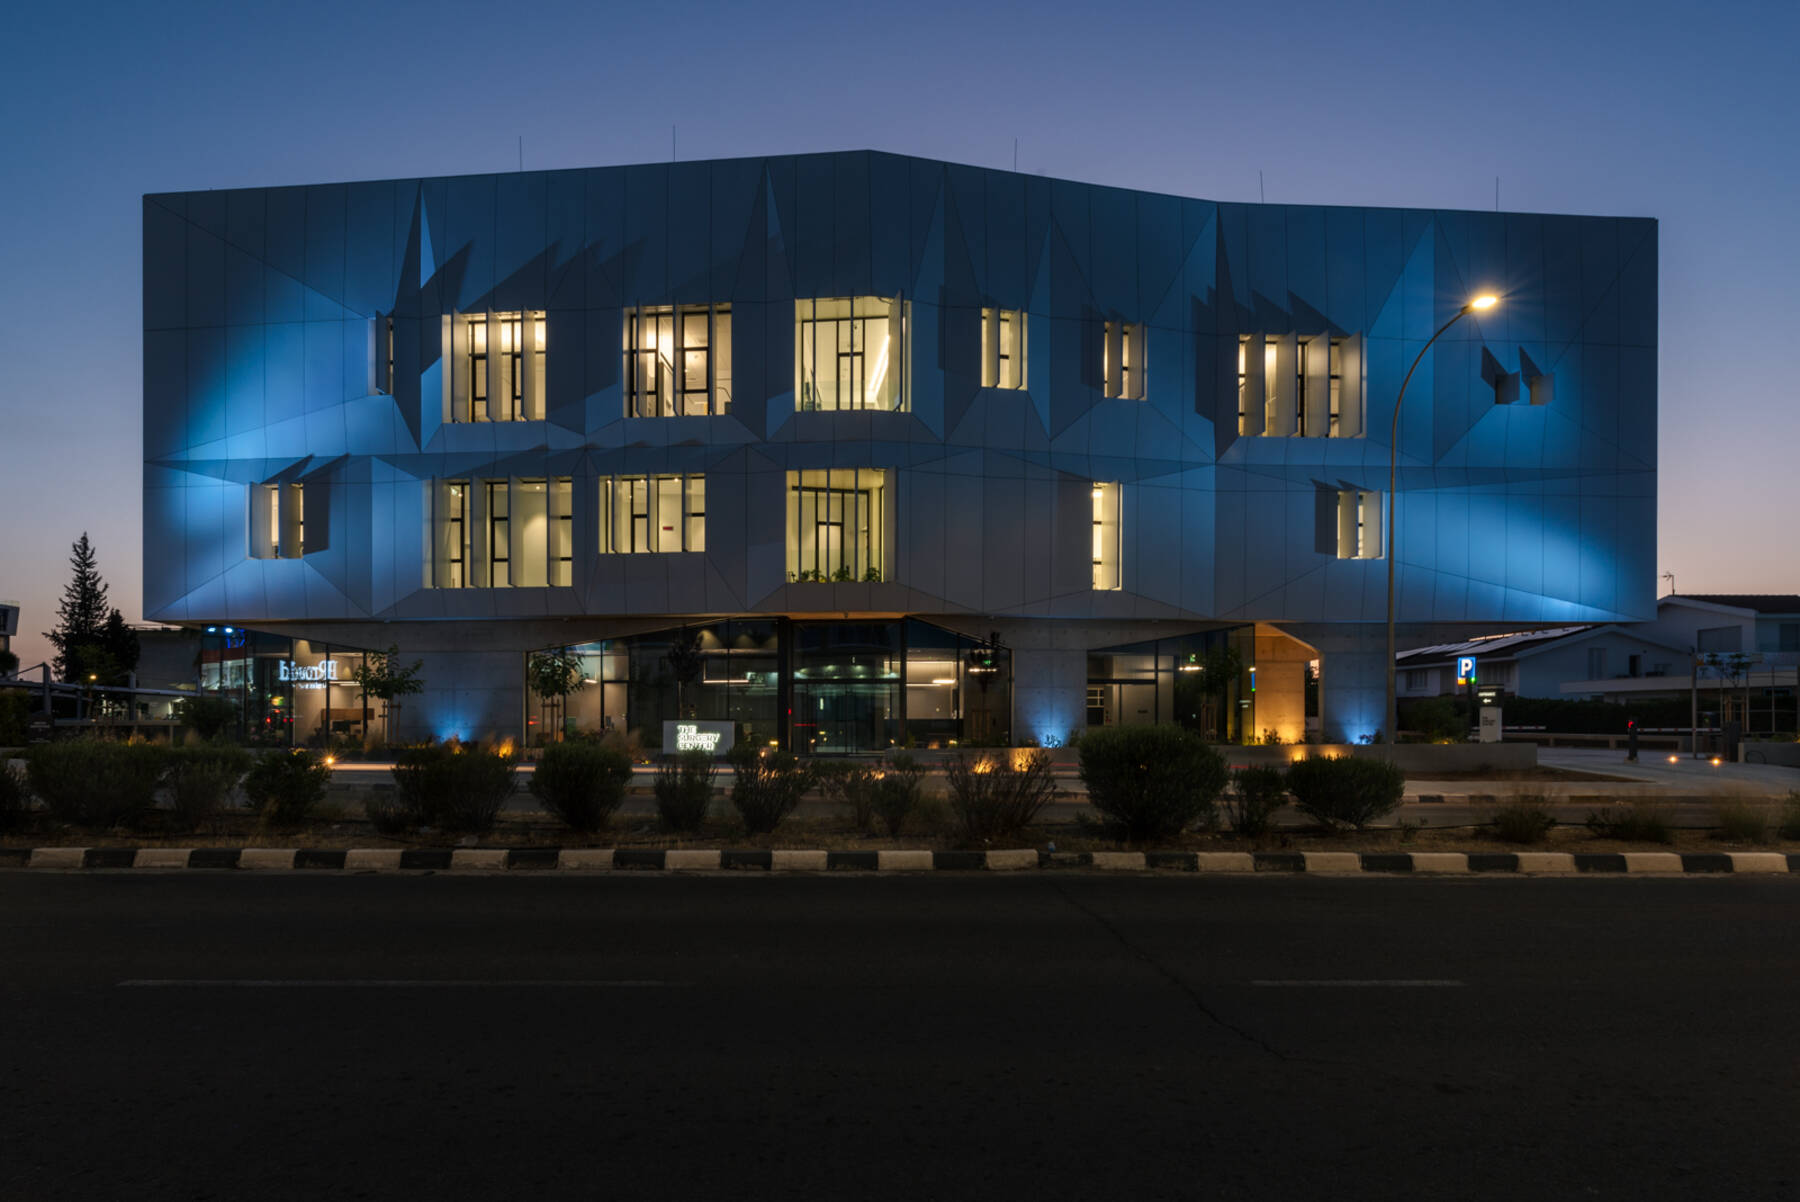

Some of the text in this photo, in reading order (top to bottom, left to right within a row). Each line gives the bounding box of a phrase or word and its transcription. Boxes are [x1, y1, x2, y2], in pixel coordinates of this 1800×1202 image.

[1461, 659, 1473, 676] P
[677, 725, 697, 734] THE
[677, 733, 721, 743] SURGERY
